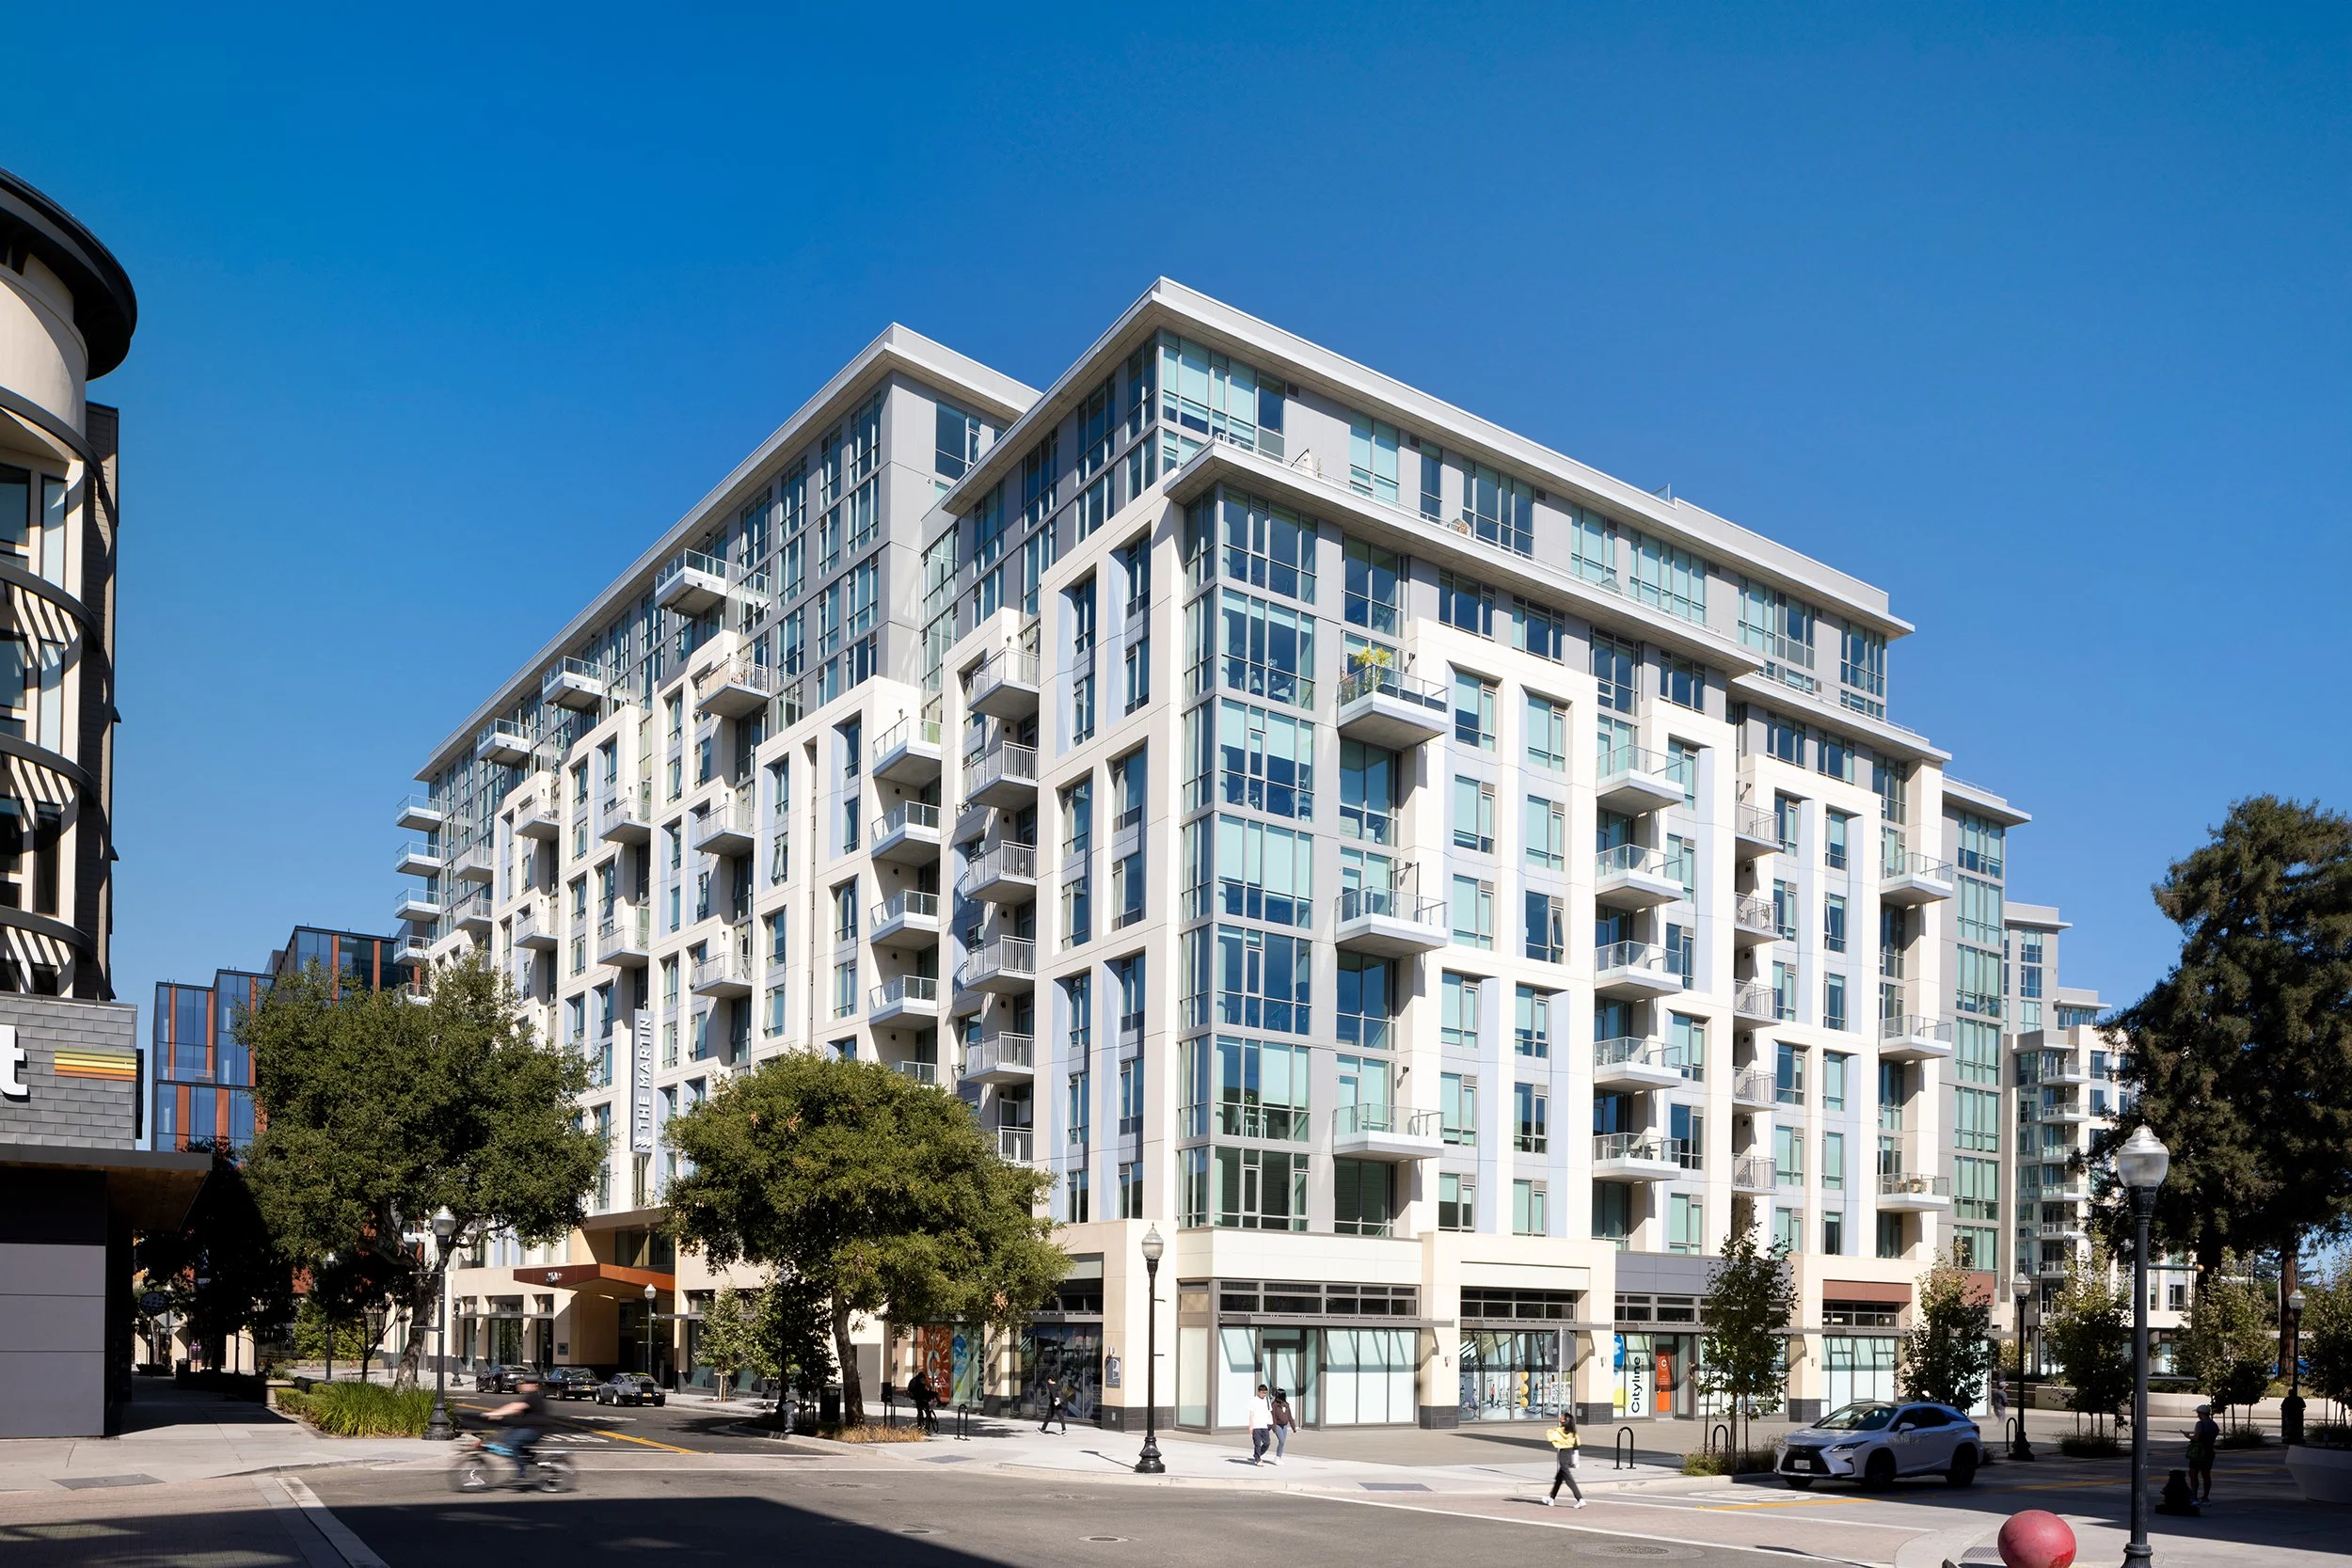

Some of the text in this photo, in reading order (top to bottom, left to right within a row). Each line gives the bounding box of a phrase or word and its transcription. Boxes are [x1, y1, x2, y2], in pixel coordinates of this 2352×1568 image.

[639, 1018, 651, 1131] THE MARTIN
[1631, 1356, 1643, 1413] Cityline
